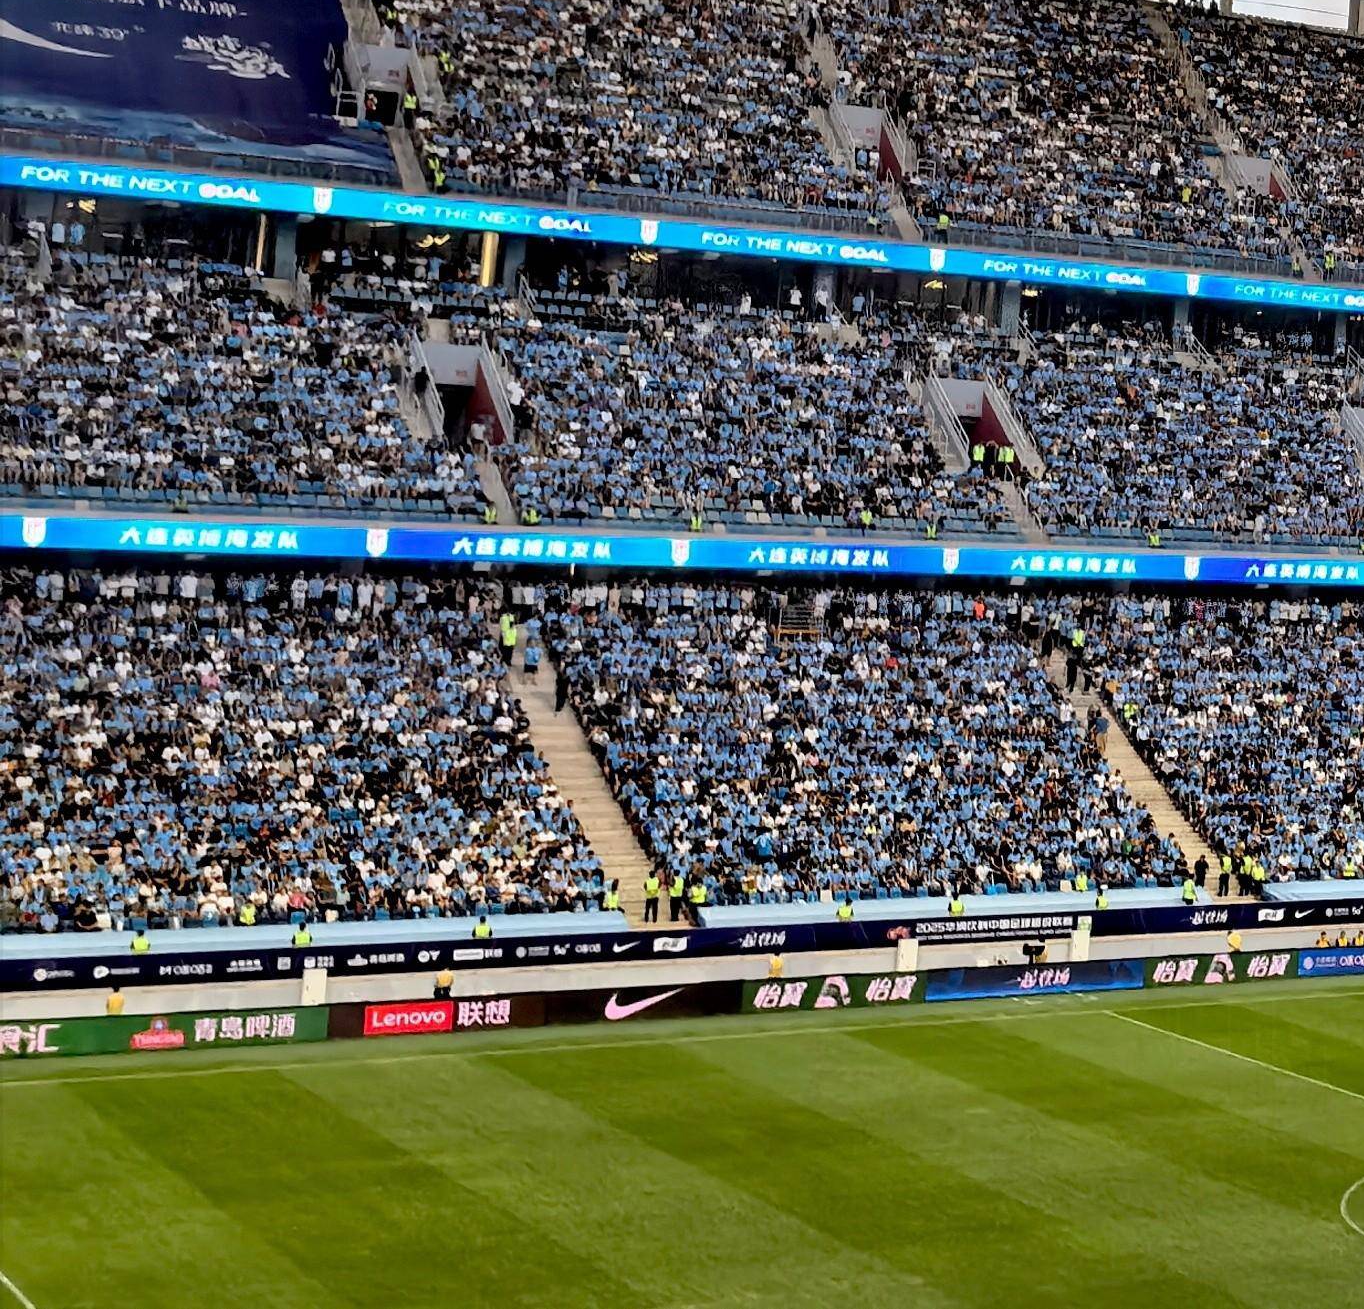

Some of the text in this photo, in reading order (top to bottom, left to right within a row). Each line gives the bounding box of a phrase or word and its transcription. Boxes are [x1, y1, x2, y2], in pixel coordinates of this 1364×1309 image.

[21, 165, 260, 203] FOR THE NEXT GOAL
[383, 202, 591, 232] FOR THE NEXT GOAL
[701, 233, 887, 262] FOR THE NEXT GOAL
[983, 259, 1145, 286] FOR THE NEXT GOAL
[1234, 285, 1265, 296] FOR
[1270, 288, 1297, 299] THE
[1301, 291, 1339, 303] NEXT
[120, 527, 297, 549] 大连英博海发队
[452, 537, 610, 558] 大连英博海发队
[750, 547, 888, 567] 大连英博海发队
[1012, 556, 1135, 573] 大连英博海发队
[371, 999, 511, 1028] Lenovo 联想
[194, 1012, 296, 1043] 青岛啤酒
